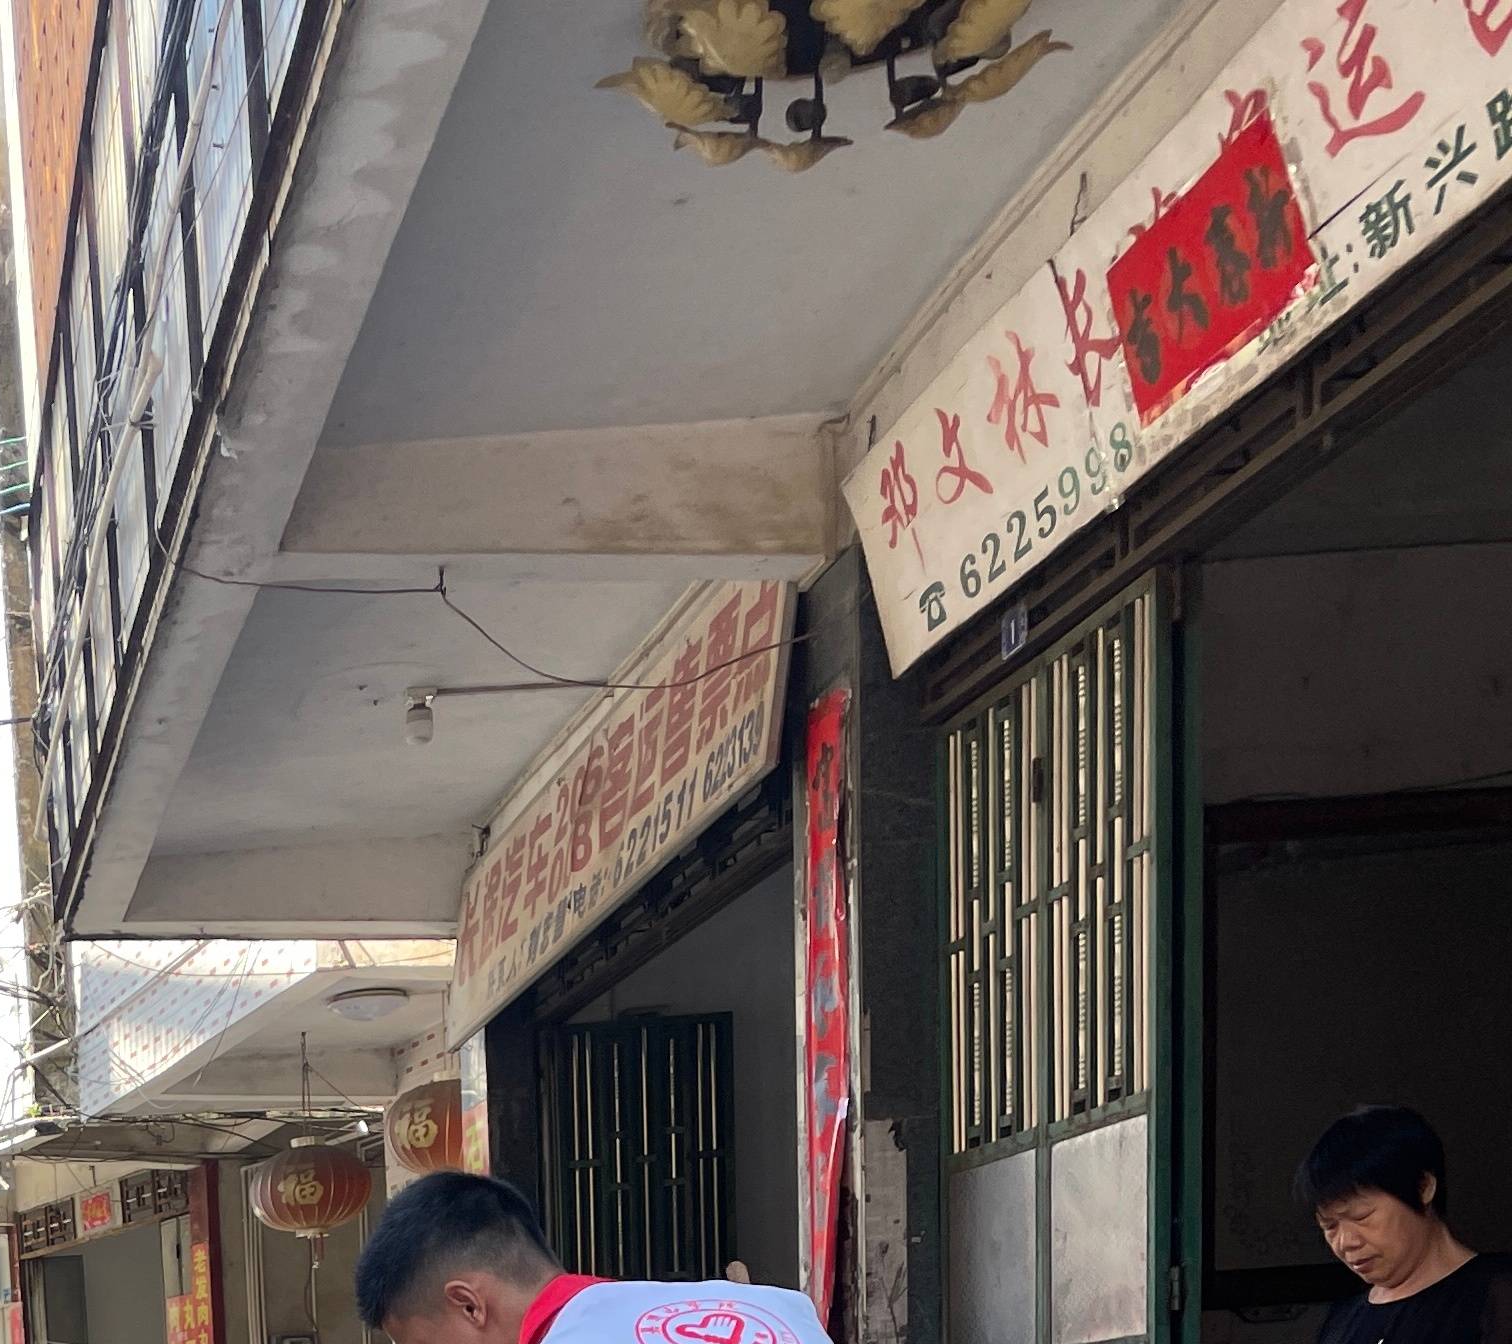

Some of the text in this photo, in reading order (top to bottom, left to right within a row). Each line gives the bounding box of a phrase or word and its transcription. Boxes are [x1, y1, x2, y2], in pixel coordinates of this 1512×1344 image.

[959, 421, 1133, 598] 6225998
[394, 1098, 439, 1150] 福
[277, 1166, 325, 1206] 福
